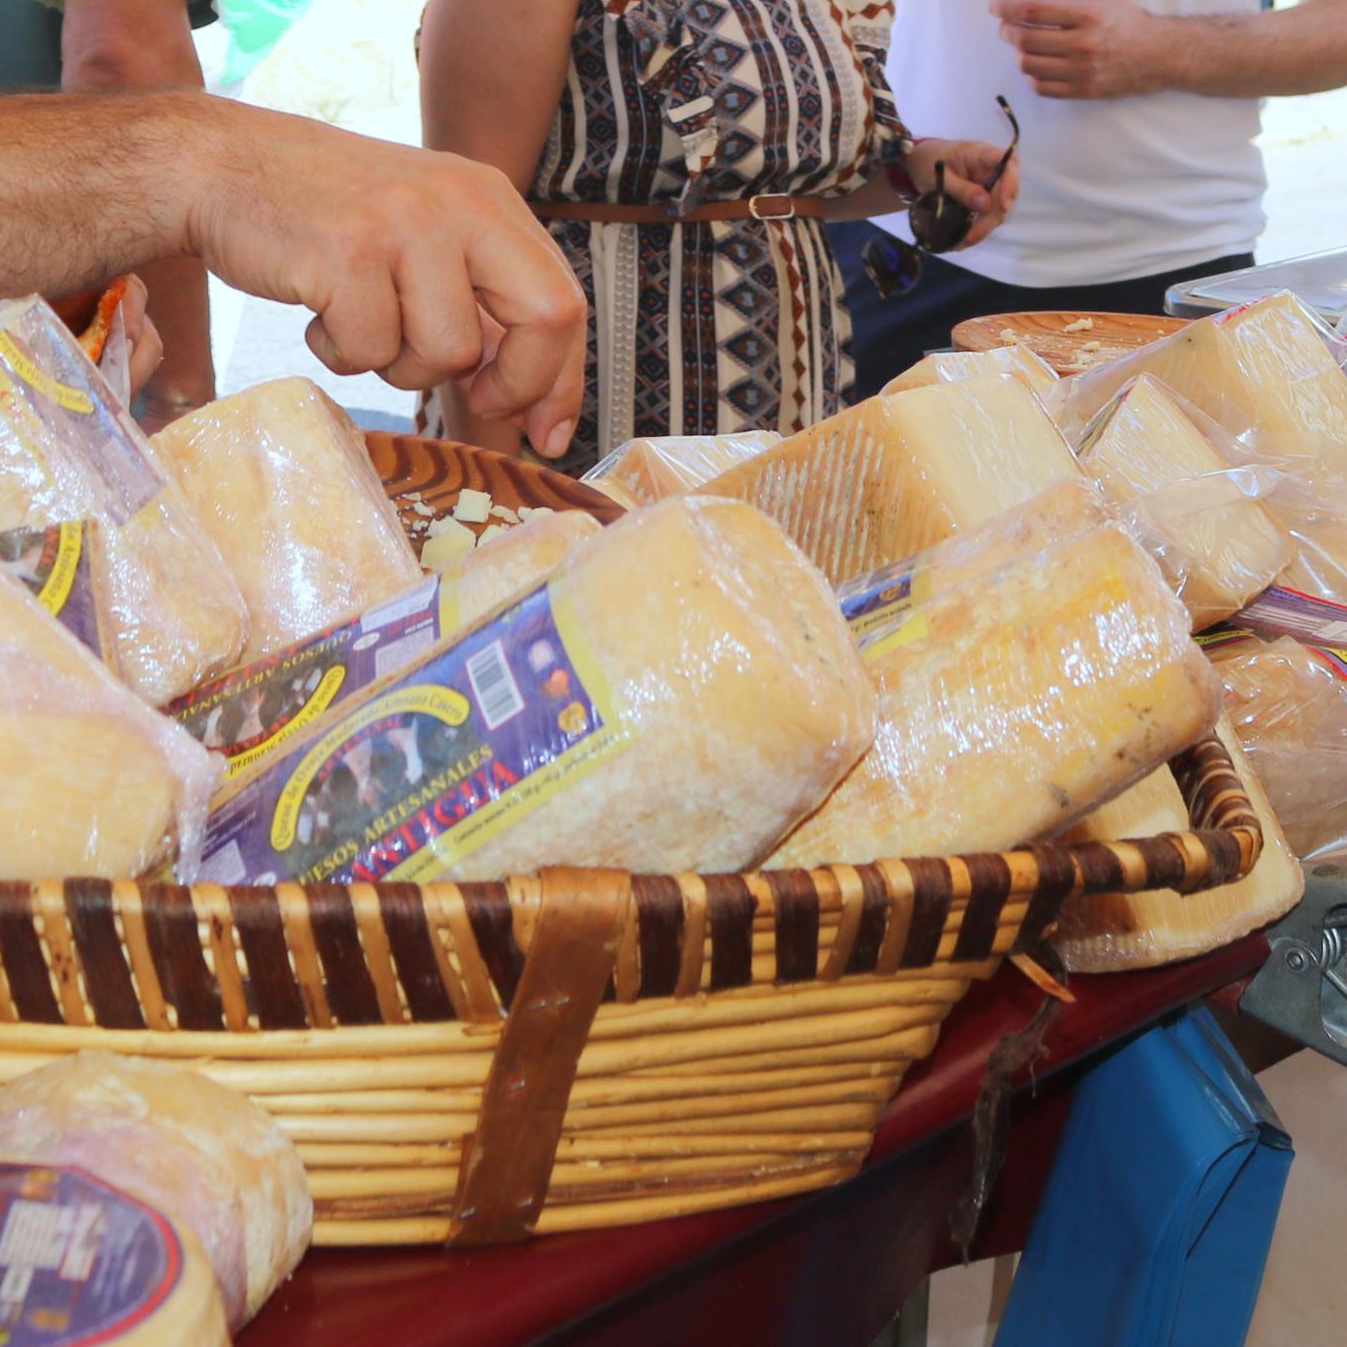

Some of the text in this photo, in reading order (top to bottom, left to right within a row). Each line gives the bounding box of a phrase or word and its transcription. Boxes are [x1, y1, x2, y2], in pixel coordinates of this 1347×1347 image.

[283, 630, 353, 669] QUESOS
[278, 802, 295, 846] Queso
[295, 747, 327, 784] Oveja
[428, 692, 464, 721] Casero
[300, 838, 360, 887] UESOS
[363, 742, 494, 846] ARTESANALES
